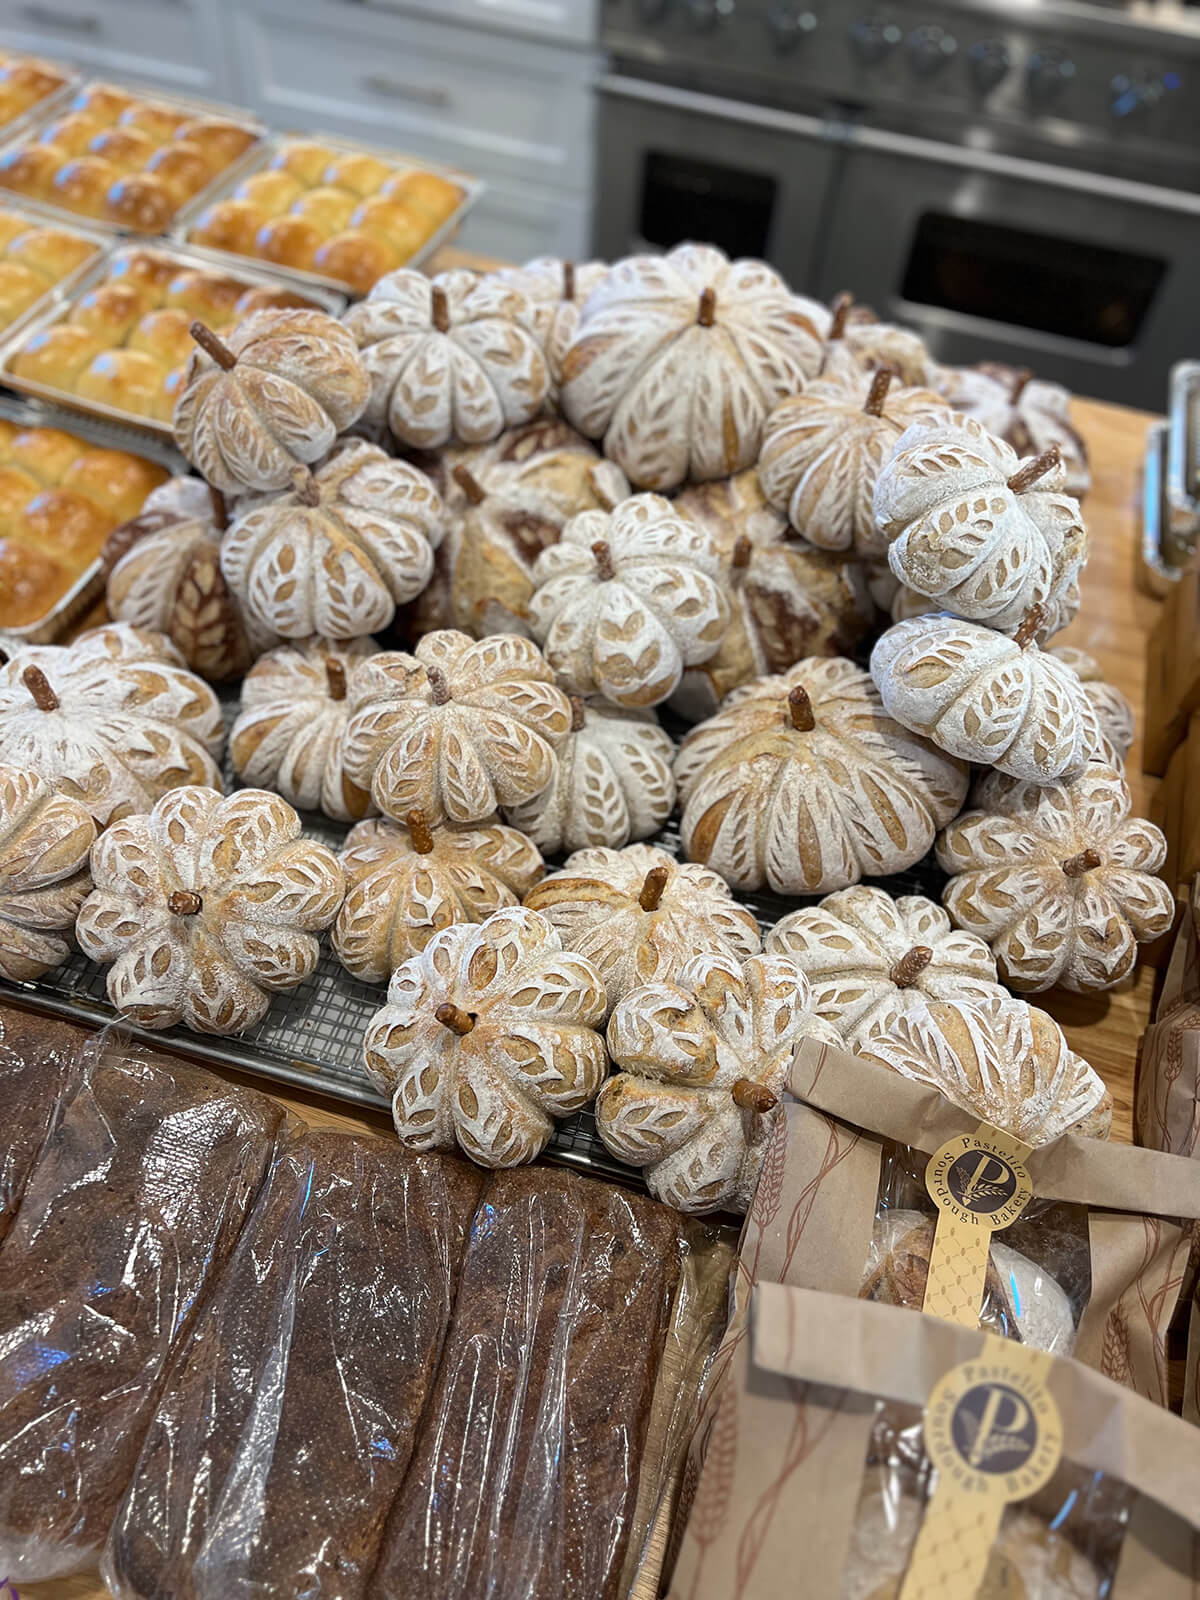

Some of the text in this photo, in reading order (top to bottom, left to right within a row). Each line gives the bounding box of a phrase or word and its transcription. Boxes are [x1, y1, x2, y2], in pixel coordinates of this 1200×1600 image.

[962, 1137, 1026, 1179] Pastelito
[933, 1152, 1031, 1226] Sourdough Bakery
